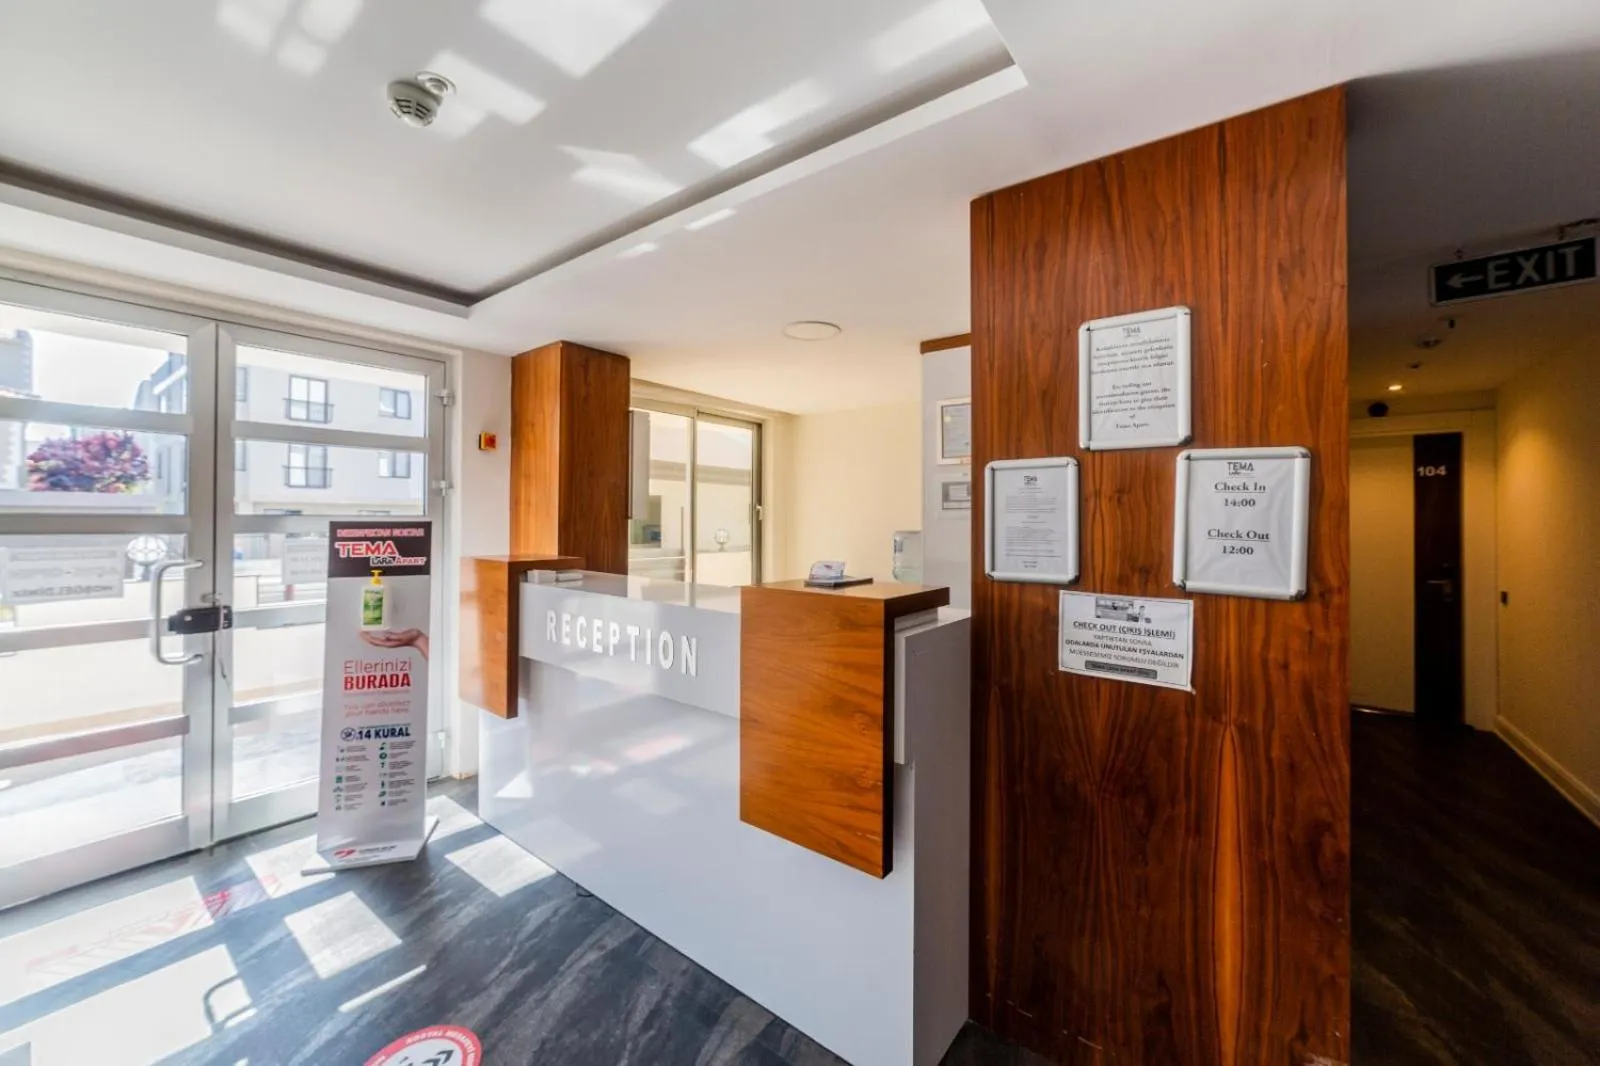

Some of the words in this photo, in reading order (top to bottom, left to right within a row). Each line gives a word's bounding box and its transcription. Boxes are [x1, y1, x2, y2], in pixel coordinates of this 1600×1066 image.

[1487, 245, 1584, 289] EXIT
[1227, 462, 1254, 472] TEMA
[1416, 465, 1448, 477] 104
[1214, 482, 1249, 491] Check
[1253, 482, 1266, 491] In
[1224, 498, 1256, 507] 14:00
[1207, 529, 1243, 539] Check
[1246, 530, 1270, 540] Out
[335, 541, 399, 557] TEMA
[1222, 545, 1254, 555] 12:00
[1073, 620, 1098, 631] CHECK
[1099, 623, 1116, 632] OUT
[546, 609, 697, 677] RECEPTION
[343, 657, 412, 674] Ellerinizi
[343, 673, 411, 691] BURADA
[358, 729, 371, 740] 14
[374, 727, 411, 739] KURAL
